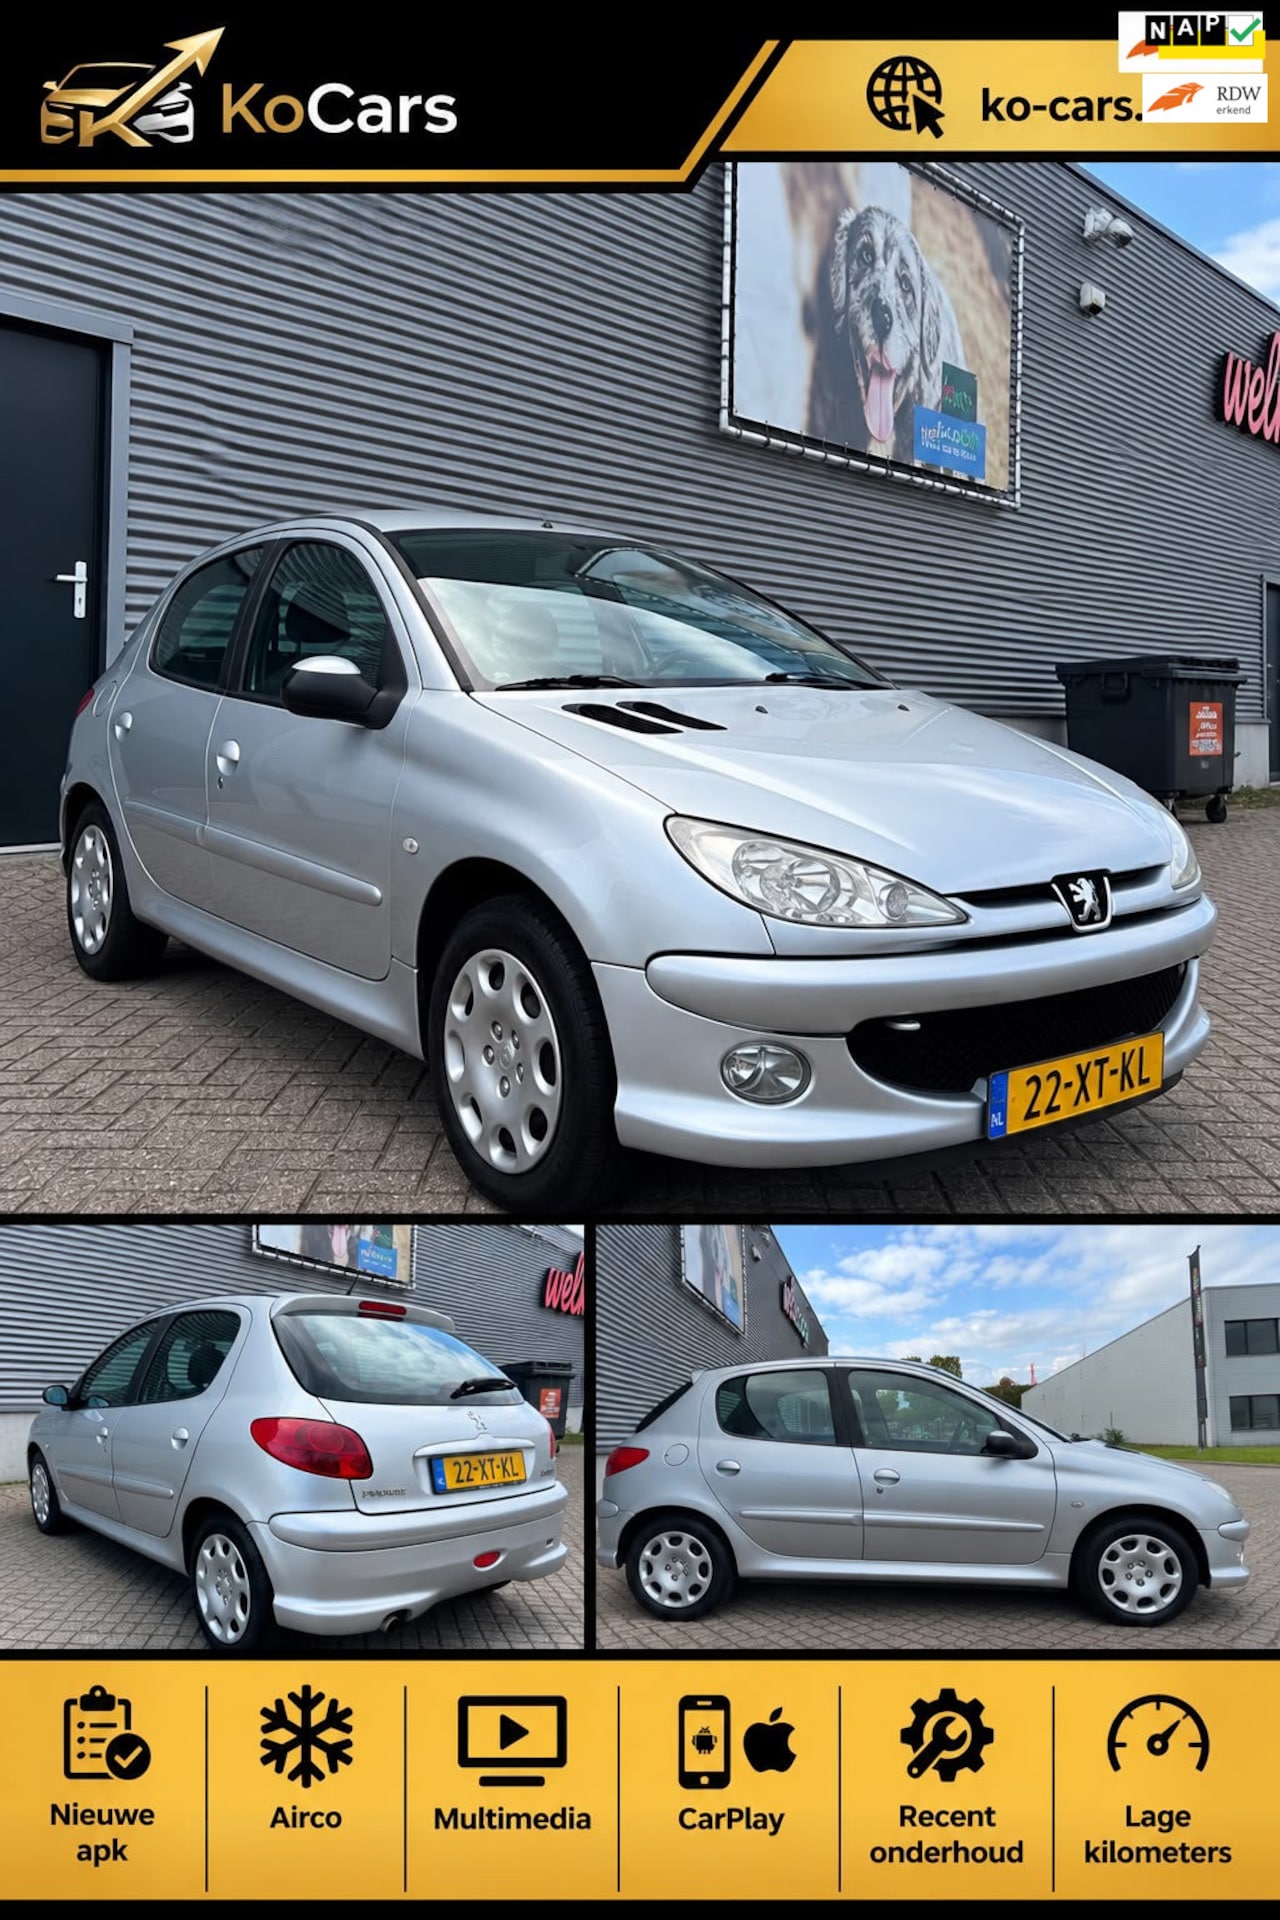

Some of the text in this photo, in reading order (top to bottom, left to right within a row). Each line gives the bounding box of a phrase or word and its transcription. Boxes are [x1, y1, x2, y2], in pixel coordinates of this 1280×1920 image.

[1024, 1046, 1151, 1121] 22-XT-KL
[990, 1112, 1004, 1127] NL
[452, 1456, 520, 1484] 22-XT-KL
